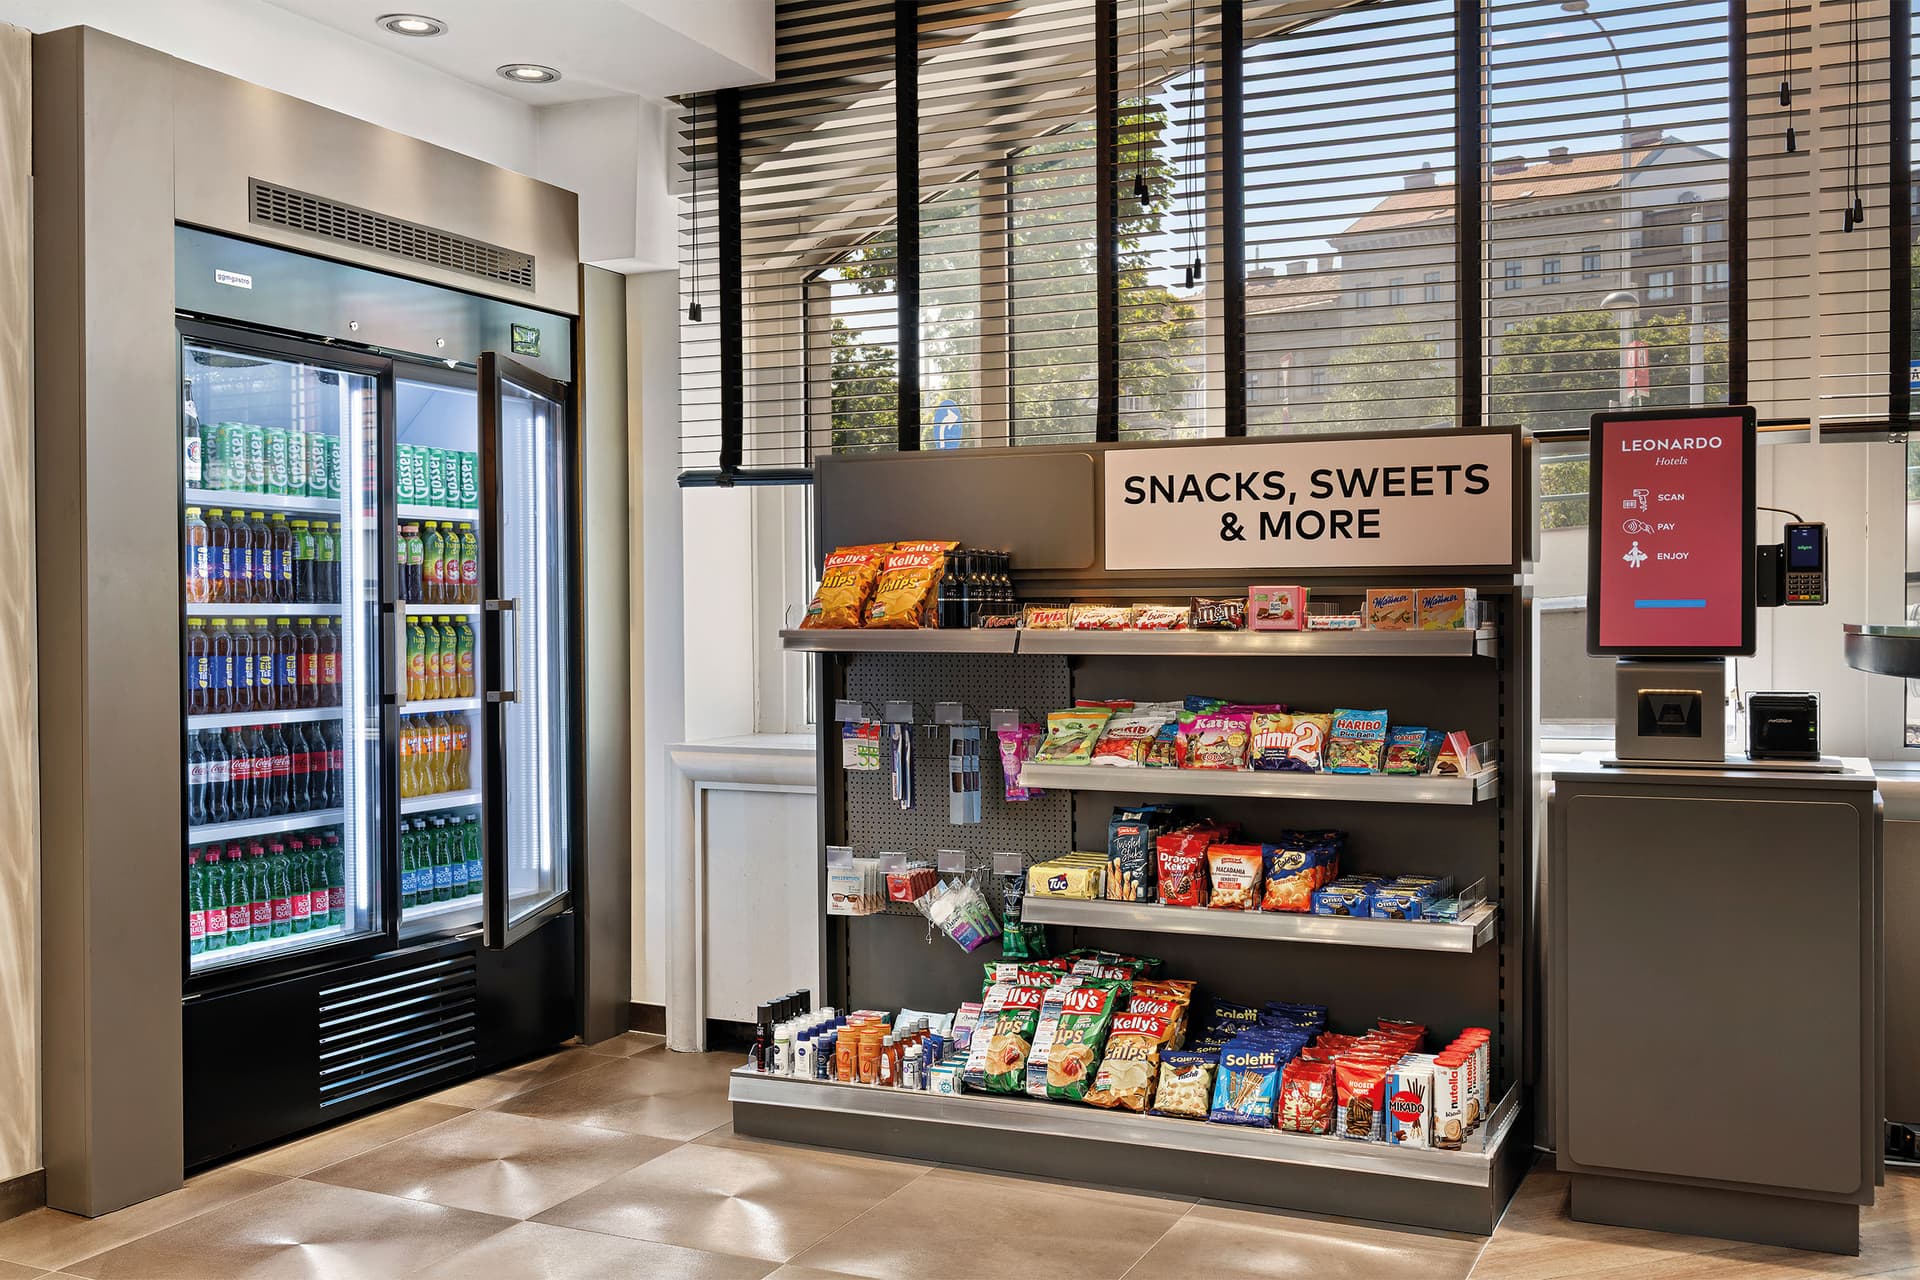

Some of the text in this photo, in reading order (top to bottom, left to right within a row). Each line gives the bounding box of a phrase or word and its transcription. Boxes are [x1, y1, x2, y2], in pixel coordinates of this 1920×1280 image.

[1621, 436, 1723, 452] LEONARDO
[1655, 456, 1688, 466] Hotels
[1123, 463, 1490, 505] SNACKS, SWEETS
[1657, 493, 1685, 501] SCAN
[1219, 508, 1380, 541] & MORE
[1657, 523, 1675, 531] PAY
[888, 553, 930, 567] Kelly's
[1657, 552, 1689, 560] ENJOY
[1373, 594, 1408, 608] Manner
[1422, 594, 1458, 608] Manner
[1033, 610, 1065, 623] Twix
[1195, 718, 1247, 732] Katjes
[1336, 719, 1382, 730] HARIBO
[1216, 866, 1246, 875] MACADAMIA
[1091, 965, 1124, 980] lly's
[1018, 974, 1051, 986] lly's
[1008, 987, 1040, 1005] lly's
[1063, 989, 1099, 1010] lly's
[1130, 999, 1168, 1015] Kelly's
[996, 1020, 1022, 1034] IPS
[1113, 1016, 1159, 1032] Kelly's
[1052, 1029, 1084, 1044] IPS
[1105, 1046, 1148, 1060] CHIPS
[1226, 1052, 1275, 1066] Soletti
[1449, 1071, 1458, 1109] nutella
[1389, 1100, 1424, 1114] MIKADO
